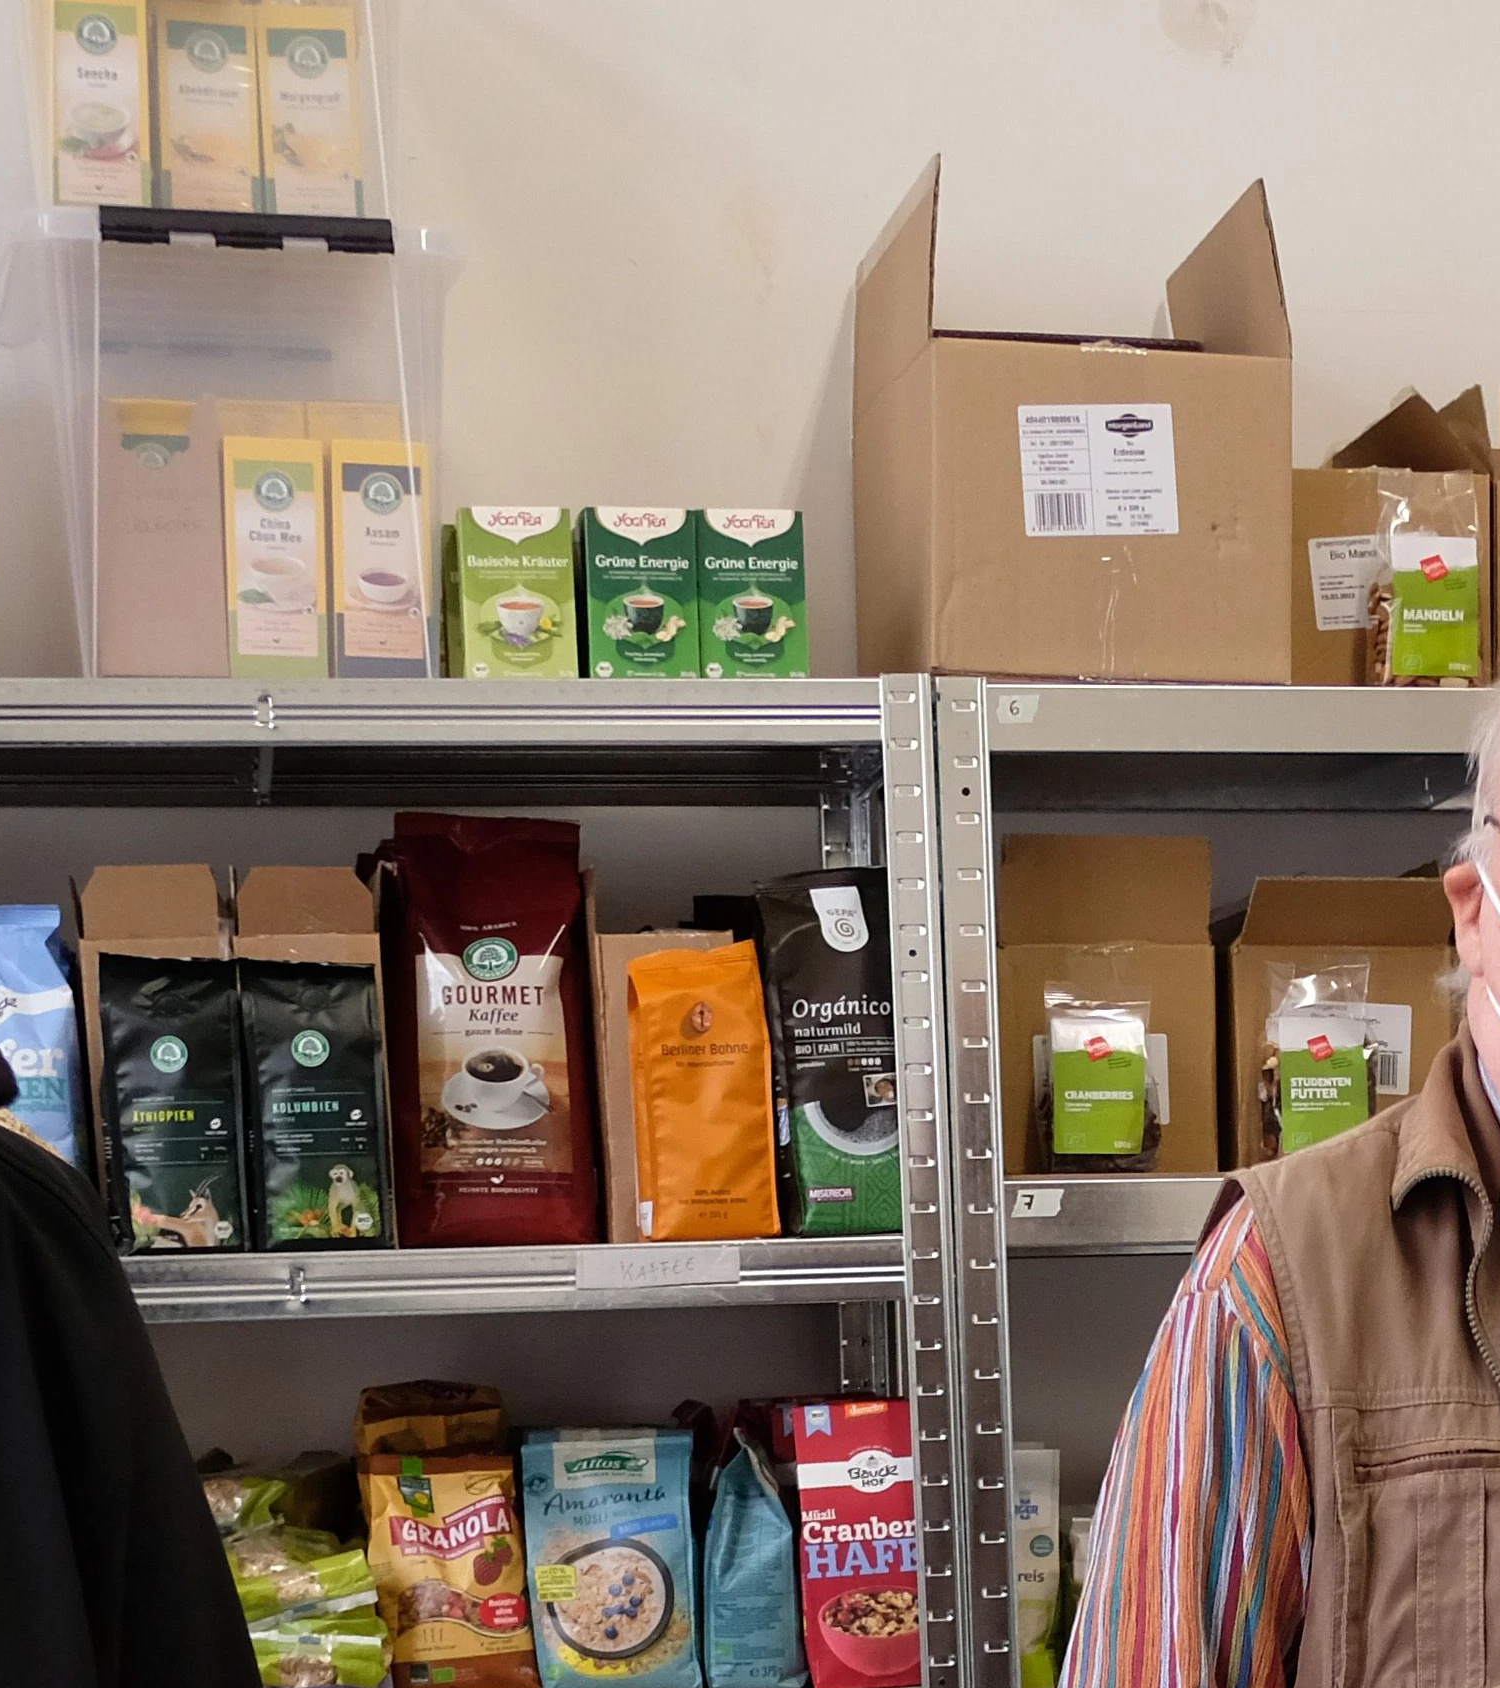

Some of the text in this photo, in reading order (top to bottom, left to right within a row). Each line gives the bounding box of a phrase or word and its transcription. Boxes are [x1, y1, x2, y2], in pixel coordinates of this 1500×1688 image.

[259, 517, 292, 531] China
[487, 513, 521, 528] YOGI
[613, 513, 646, 528] YOGI
[722, 514, 755, 530] YOGI
[249, 529, 303, 544] Chun Mee
[364, 526, 401, 540] Assam
[466, 555, 569, 568] Basische Kräuter
[594, 554, 690, 571] Grüne Energie
[704, 556, 799, 572] Grüne Energie
[1403, 609, 1464, 622] MANDELN
[1009, 699, 1020, 716] 6
[441, 984, 545, 1006] GOURMET
[467, 1007, 520, 1024] Kaffee
[791, 994, 891, 1025] Orgánico
[794, 1022, 862, 1038] naturmild
[660, 1041, 749, 1057] Berliner Bohne
[795, 1044, 812, 1055] BIO
[818, 1042, 840, 1054] FAIR
[1, 1038, 64, 1076] fer
[1289, 1076, 1352, 1089] STUDENTEN
[1064, 1089, 1135, 1101] CRANBERRIES
[1289, 1086, 1339, 1100] FUTTER
[271, 1101, 341, 1115] KOLUMBIEN
[572, 1456, 622, 1472] Allos
[847, 1465, 899, 1481] Bauck
[861, 1478, 886, 1488] HOF
[543, 1485, 667, 1517] Amaranth
[800, 1508, 837, 1522] Müsli
[401, 1508, 511, 1550] GRANOLA
[802, 1516, 916, 1544] Cranber
[803, 1538, 919, 1580] HAFE
[1017, 1570, 1045, 1583] reis
